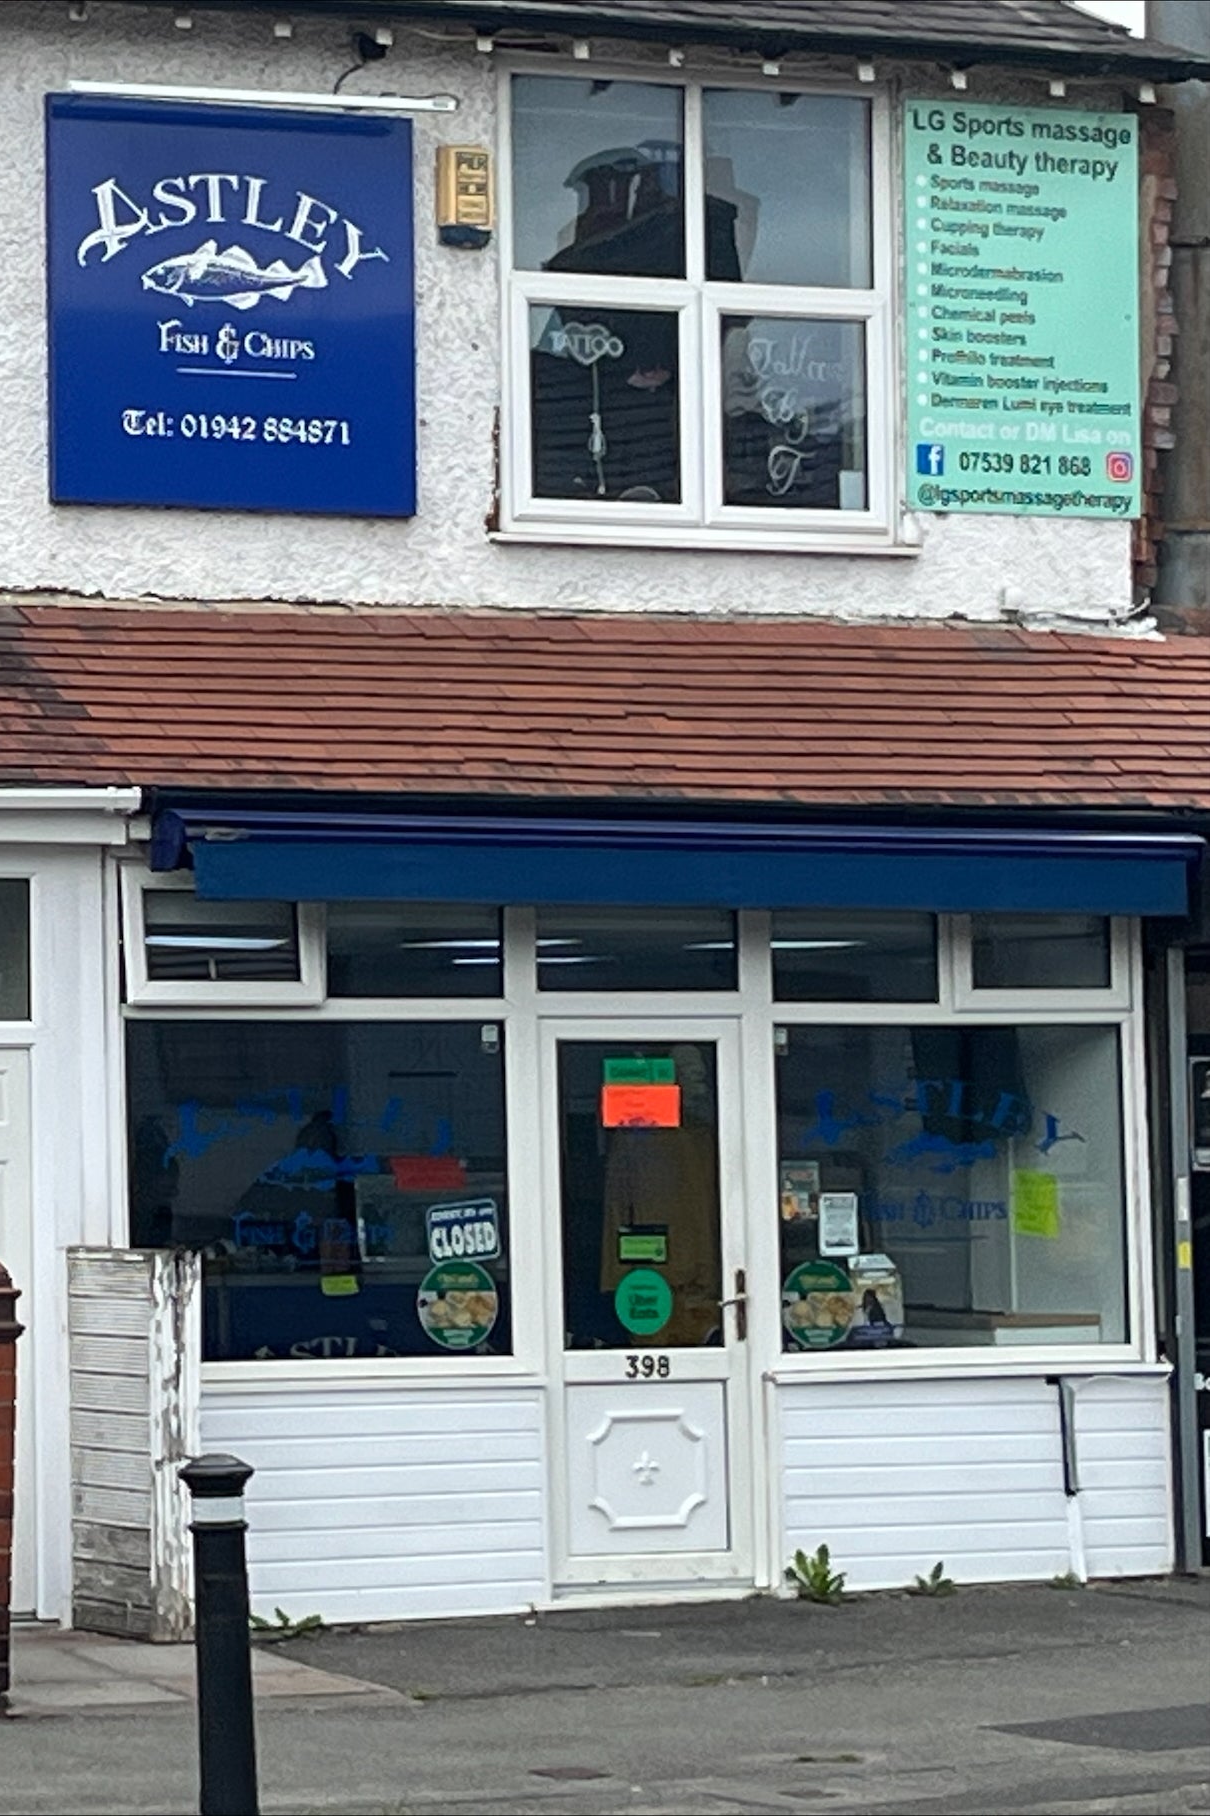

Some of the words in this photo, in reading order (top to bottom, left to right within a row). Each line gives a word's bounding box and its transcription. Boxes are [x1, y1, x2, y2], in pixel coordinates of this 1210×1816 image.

[912, 108, 945, 131] LG
[952, 111, 1024, 138] Sports
[1031, 121, 1132, 149] massage
[926, 143, 942, 165] &
[950, 144, 1028, 176] Beauty
[1034, 151, 1118, 182] therapy
[930, 174, 975, 191] Sports
[979, 180, 1039, 198] massage
[930, 195, 1003, 214] Relaxation
[1006, 204, 1067, 222] massage
[77, 173, 390, 280] ASTLEY
[930, 217, 989, 238] Cupping
[993, 222, 1045, 242] therapy
[930, 240, 980, 256] Facials
[931, 305, 996, 322] Chemical
[931, 327, 963, 342] Skin
[967, 329, 1027, 347] boosters
[989, 353, 1055, 369] treatment
[932, 372, 983, 387] Vitamin
[987, 375, 1039, 390] booster
[1042, 376, 1108, 394] injections
[1067, 401, 1131, 417] treatment
[122, 409, 174, 437] Tel:
[180, 414, 257, 440] 01942
[263, 417, 351, 446] 884871
[919, 417, 994, 441] Contact
[1000, 424, 1020, 438] or
[1026, 422, 1056, 443] DM
[1062, 423, 1101, 444] Lisa
[1106, 429, 1131, 446] on
[959, 451, 1014, 473] 07539
[1020, 453, 1051, 475] 821
[1058, 456, 1091, 477] 868
[432, 1221, 496, 1258] CLOSED
[625, 1355, 670, 1378] 398
